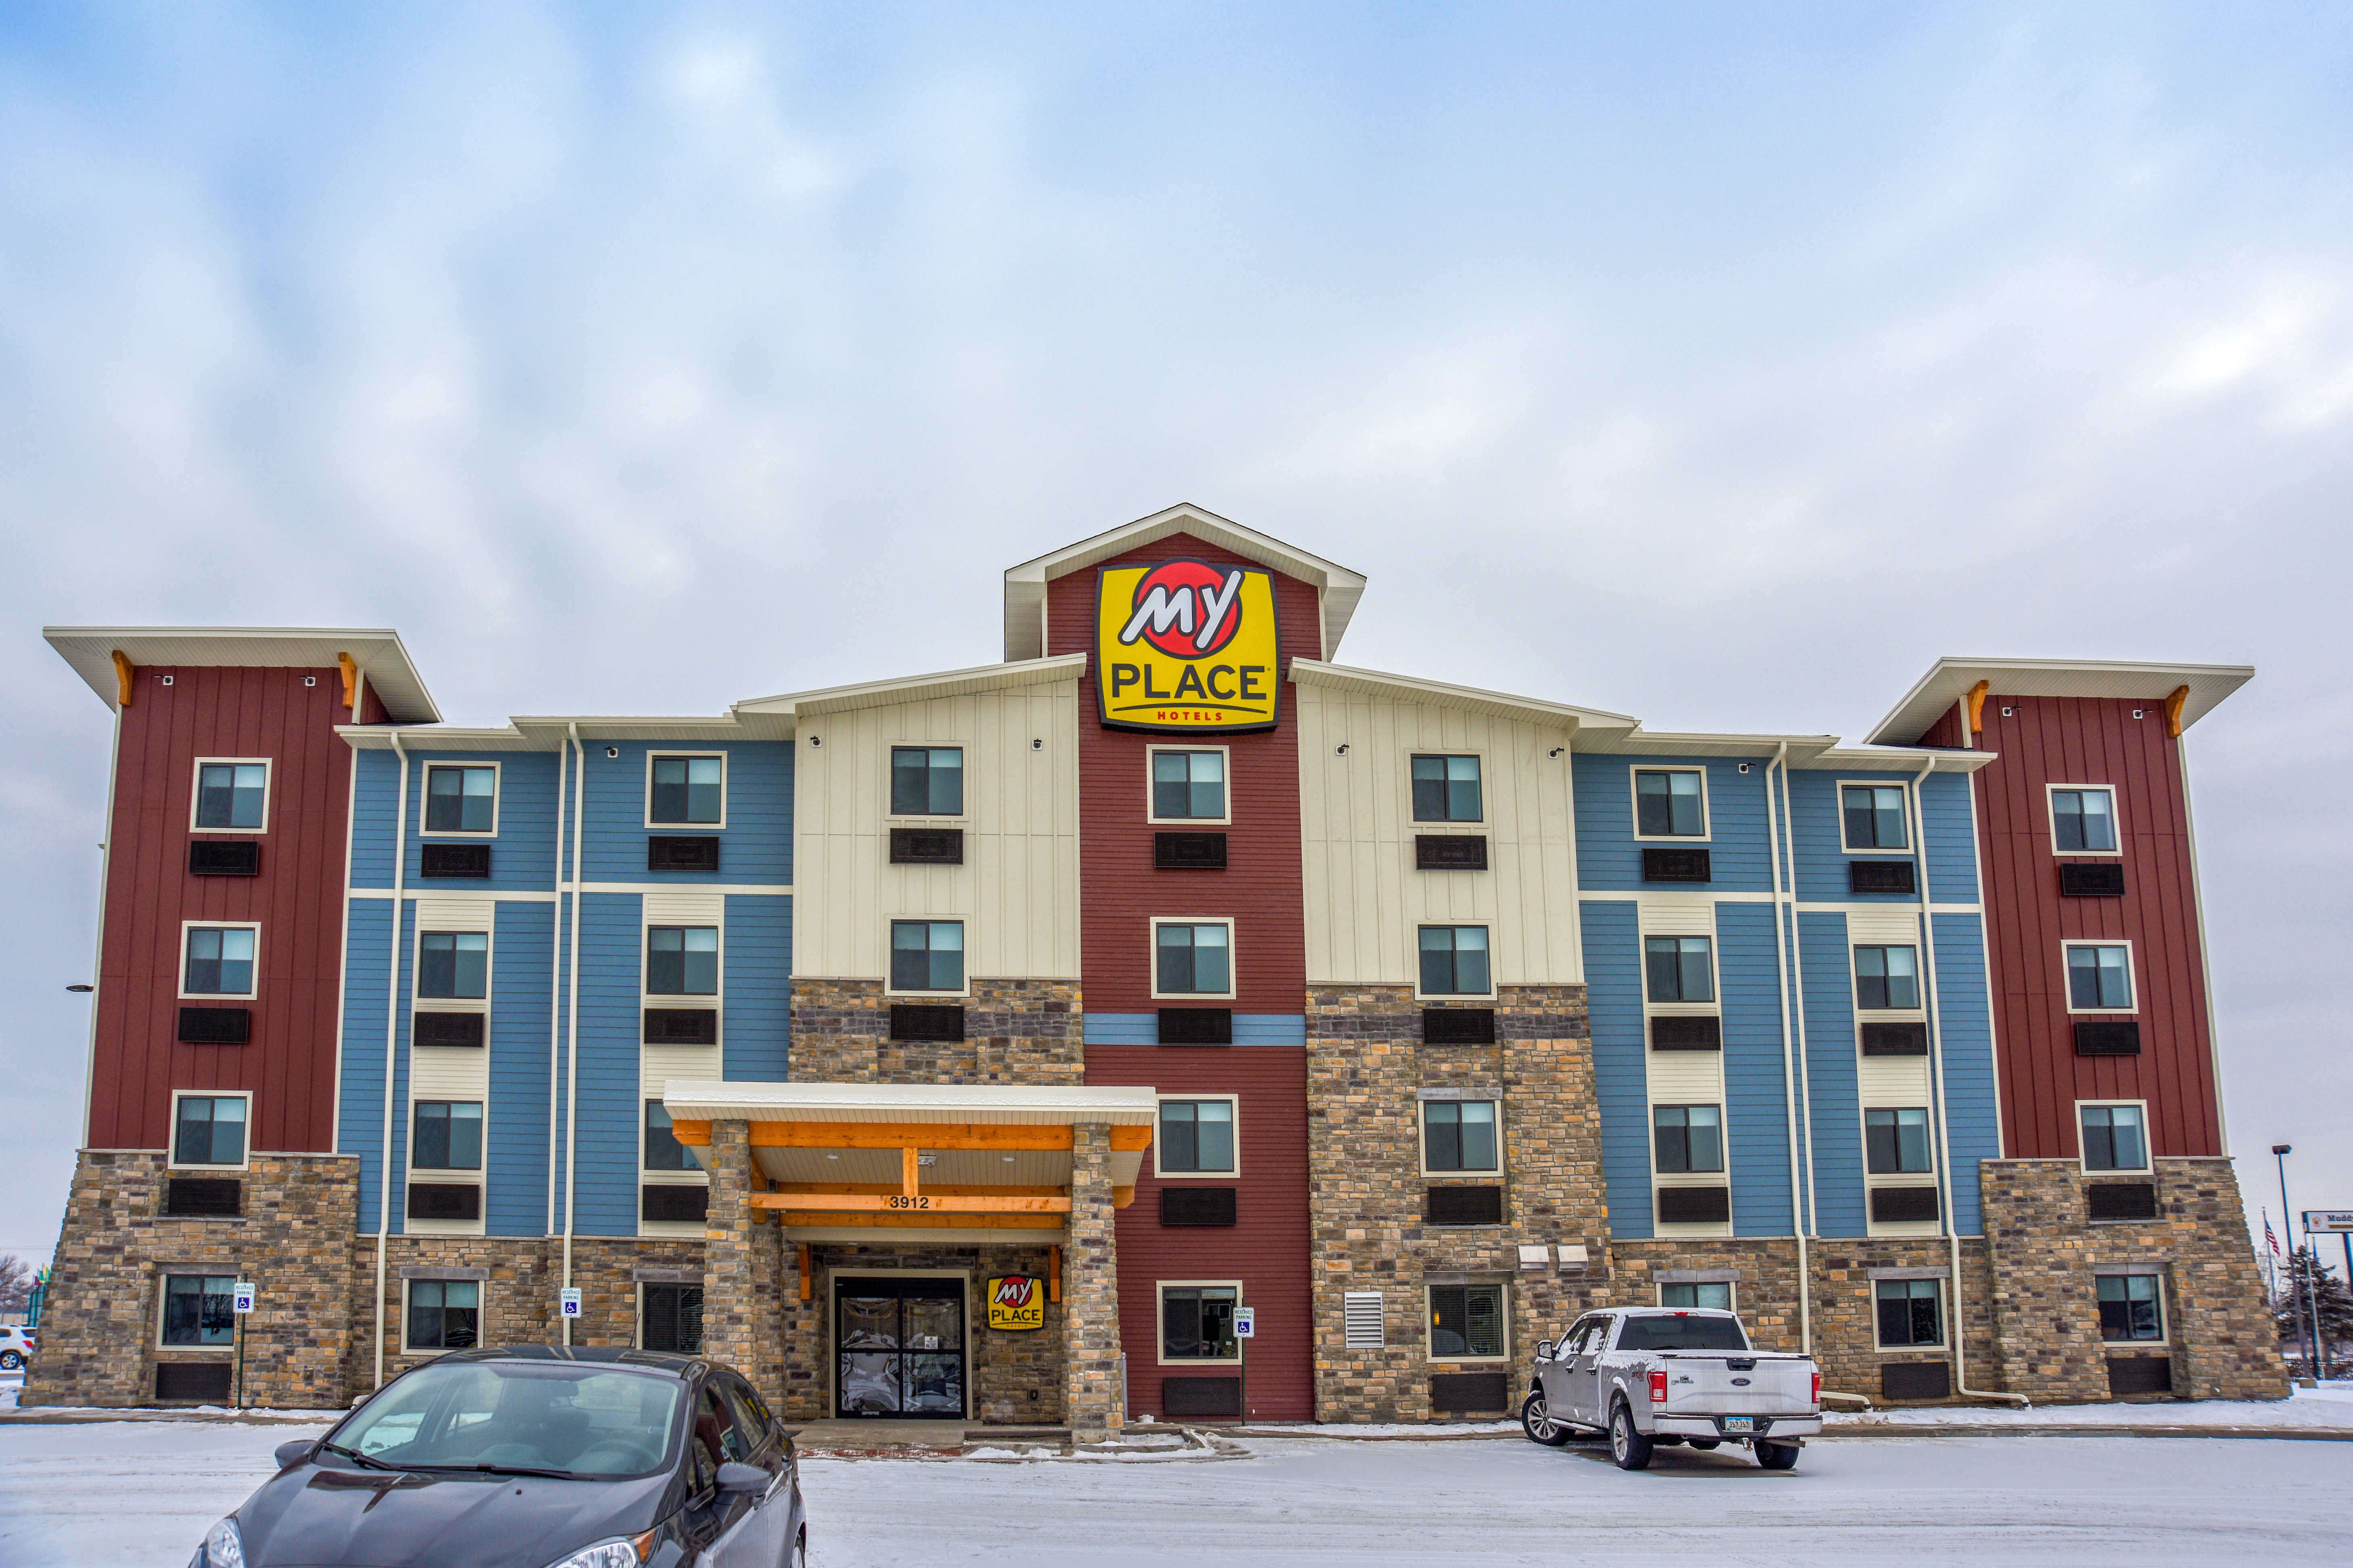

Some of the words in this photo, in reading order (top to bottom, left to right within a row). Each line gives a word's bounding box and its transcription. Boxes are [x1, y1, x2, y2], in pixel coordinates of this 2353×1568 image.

[1111, 663, 1267, 700] PLACE
[1157, 712, 1222, 721] HOTELS
[890, 1196, 929, 1209] 3912
[2326, 1215, 2353, 1223] Mudd
[992, 1309, 1040, 1321] PLACE
